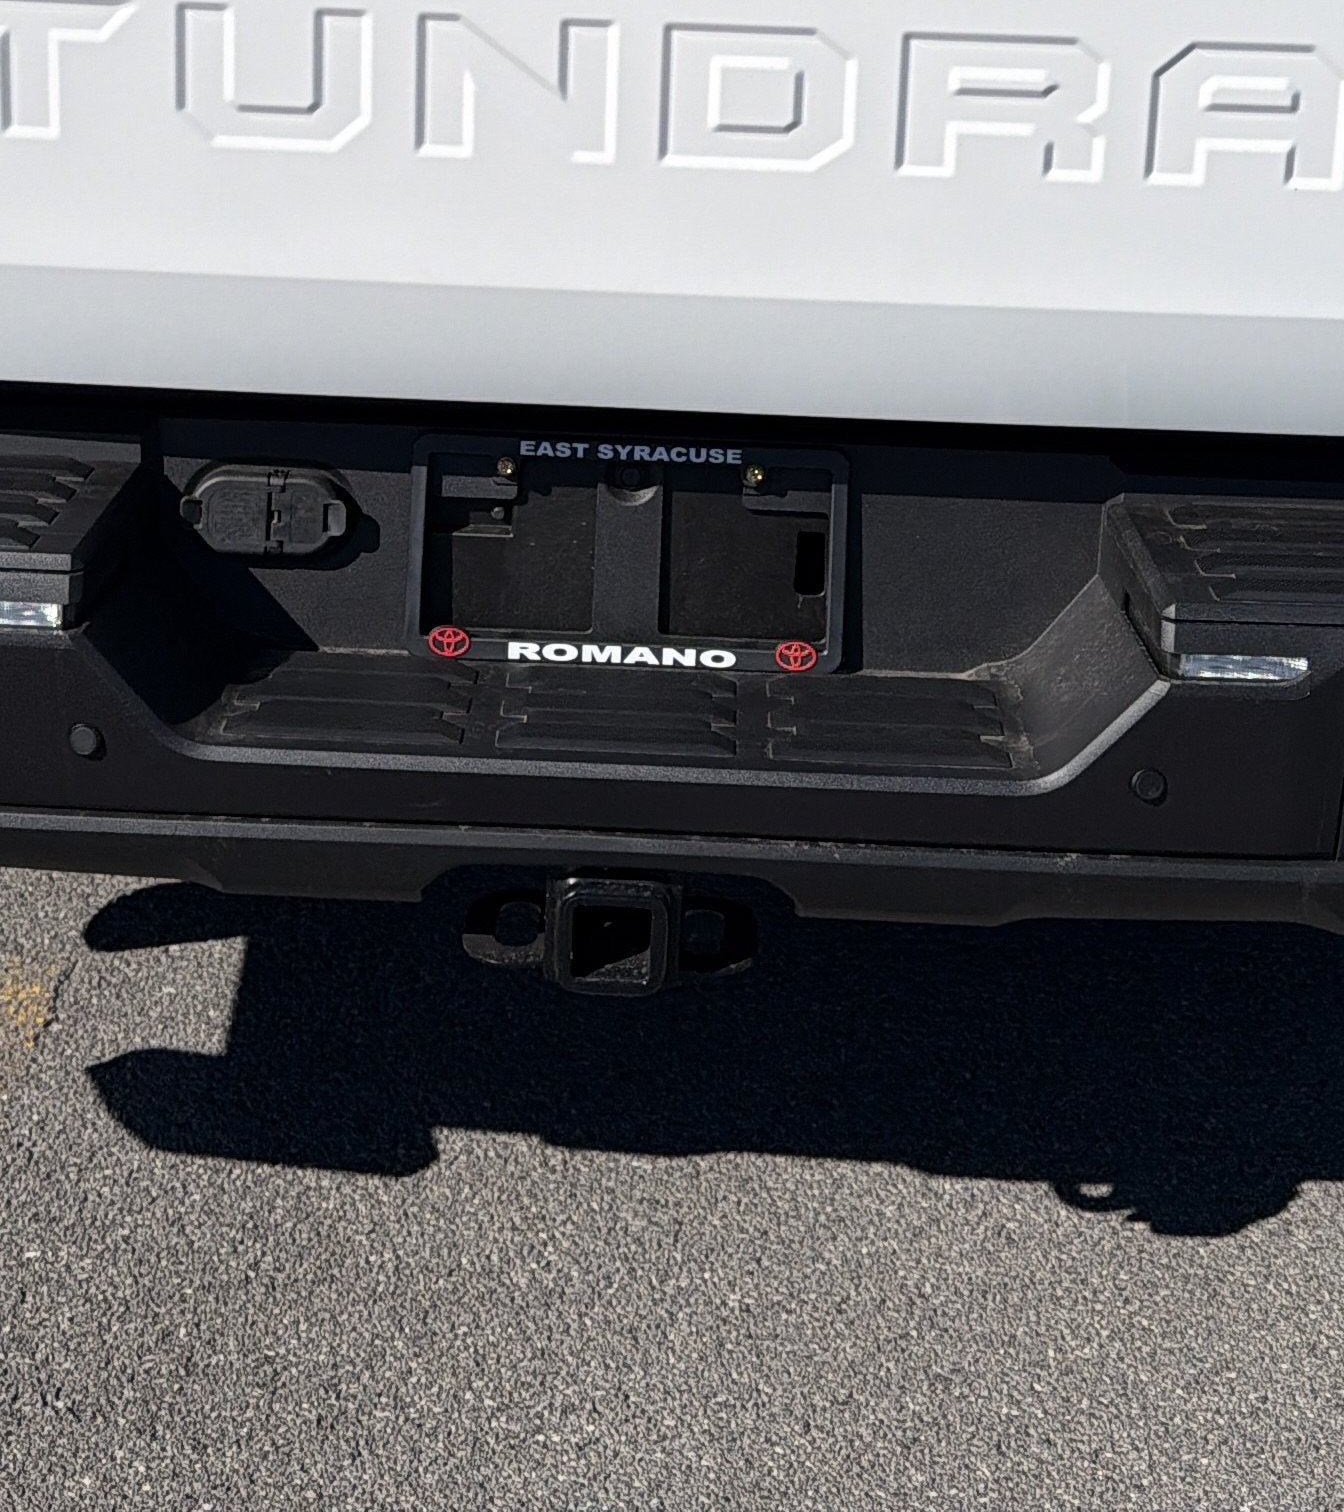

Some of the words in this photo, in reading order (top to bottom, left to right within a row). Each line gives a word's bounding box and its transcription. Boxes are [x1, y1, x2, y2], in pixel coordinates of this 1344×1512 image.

[519, 439, 590, 459] EAST
[596, 444, 743, 465] SYRACUSE
[507, 640, 738, 669] ROMANO
